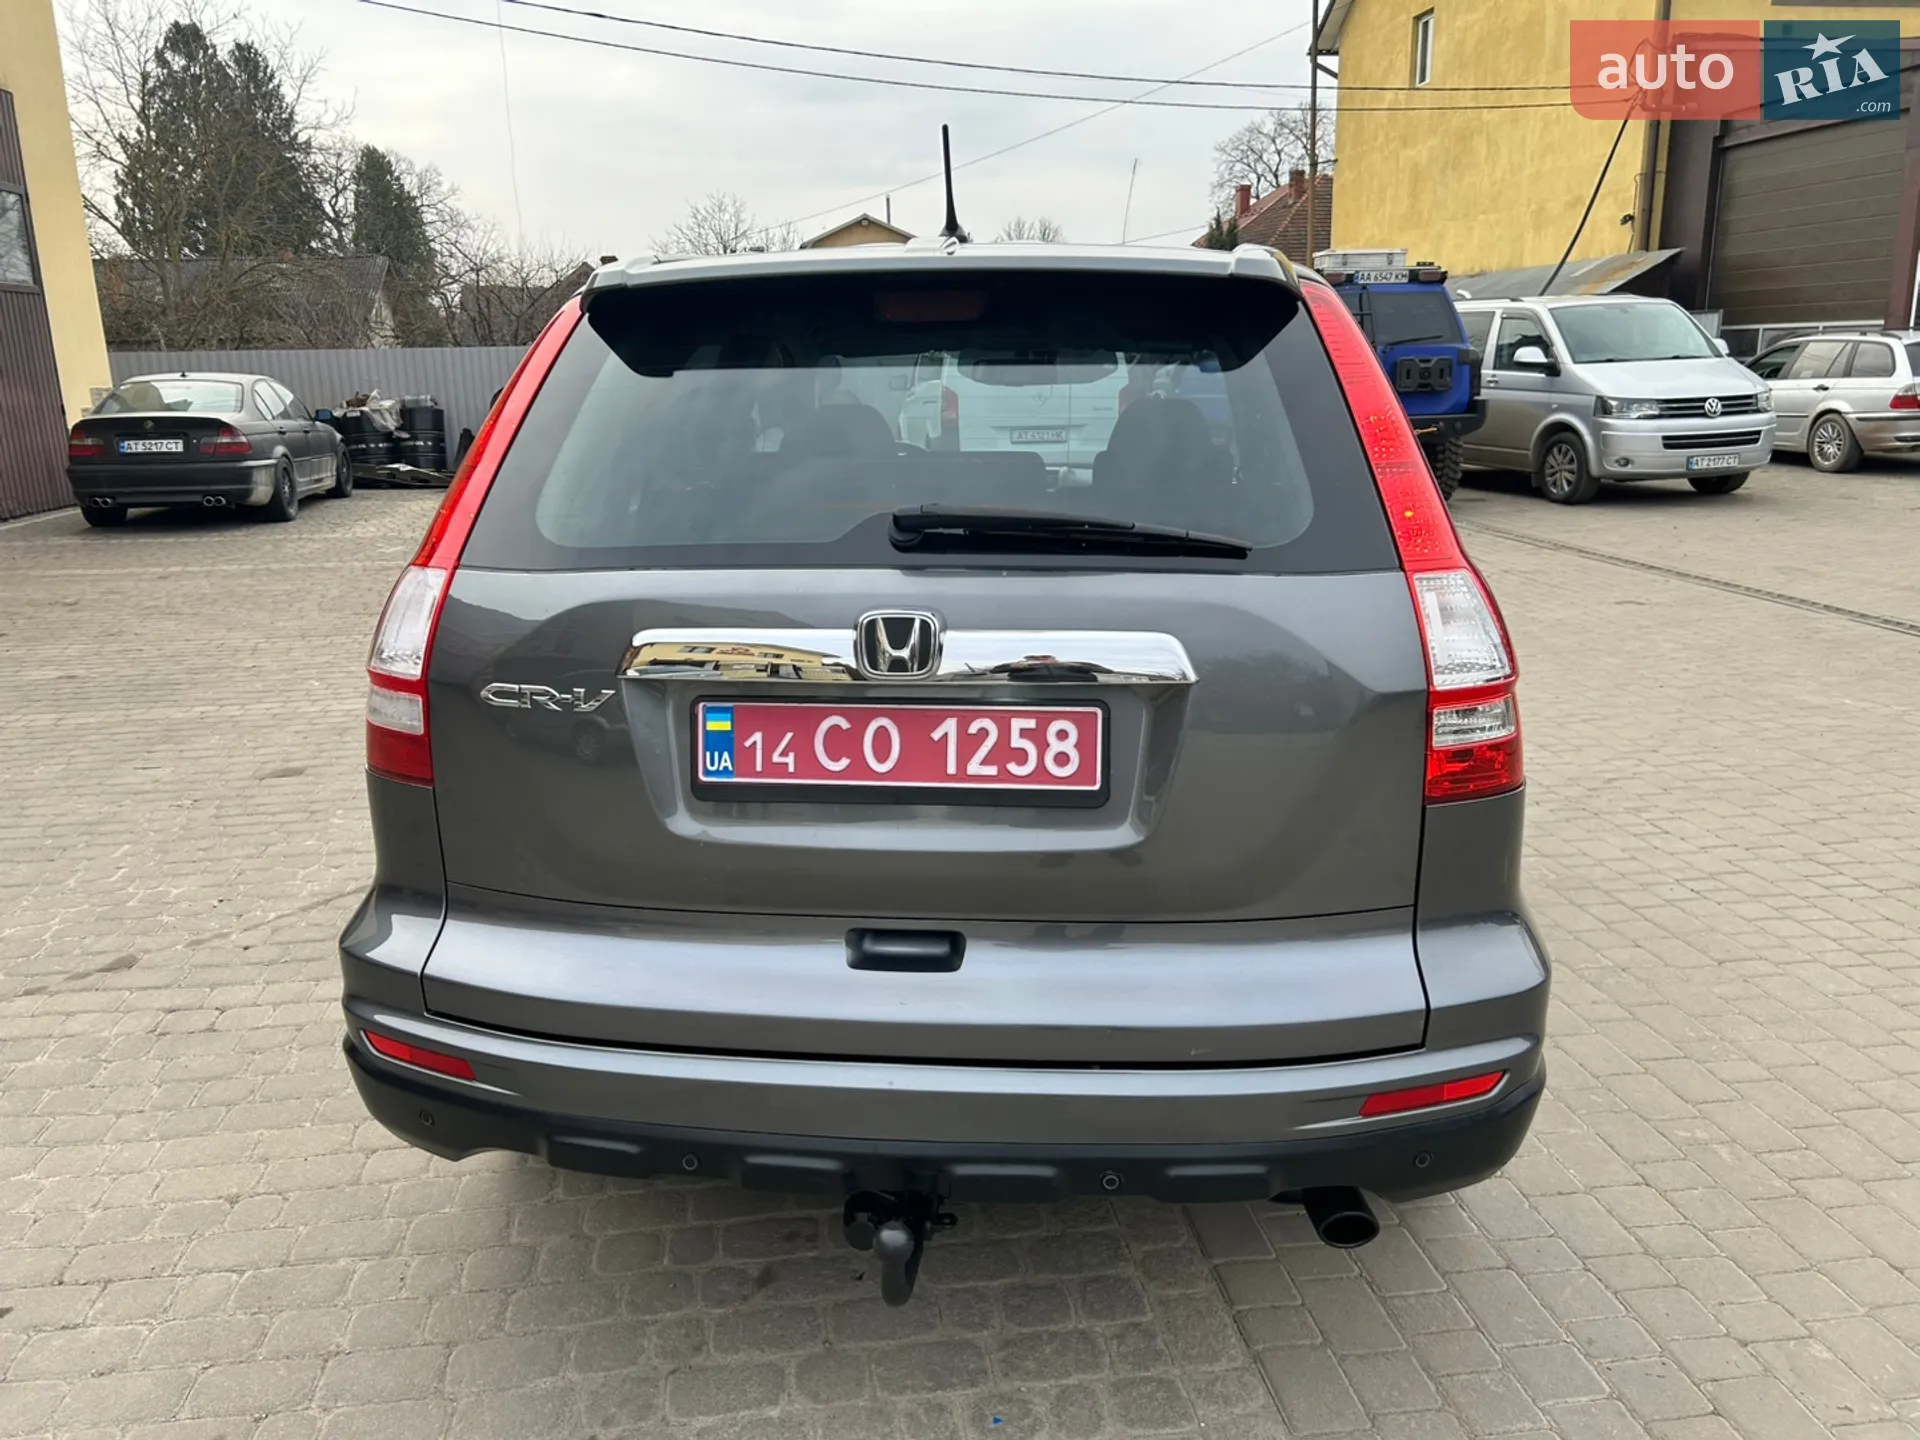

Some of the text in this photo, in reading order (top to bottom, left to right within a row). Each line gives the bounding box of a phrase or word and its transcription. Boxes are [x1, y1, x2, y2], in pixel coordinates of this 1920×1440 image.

[1360, 272, 1371, 281] AA
[1374, 271, 1393, 282] 6547
[126, 441, 180, 451] AT 5217 CT
[1694, 455, 1739, 468] AT 2177 CT
[480, 682, 616, 712] CR-V
[743, 715, 1081, 778] 14 CO 1258
[706, 751, 733, 772] UA
